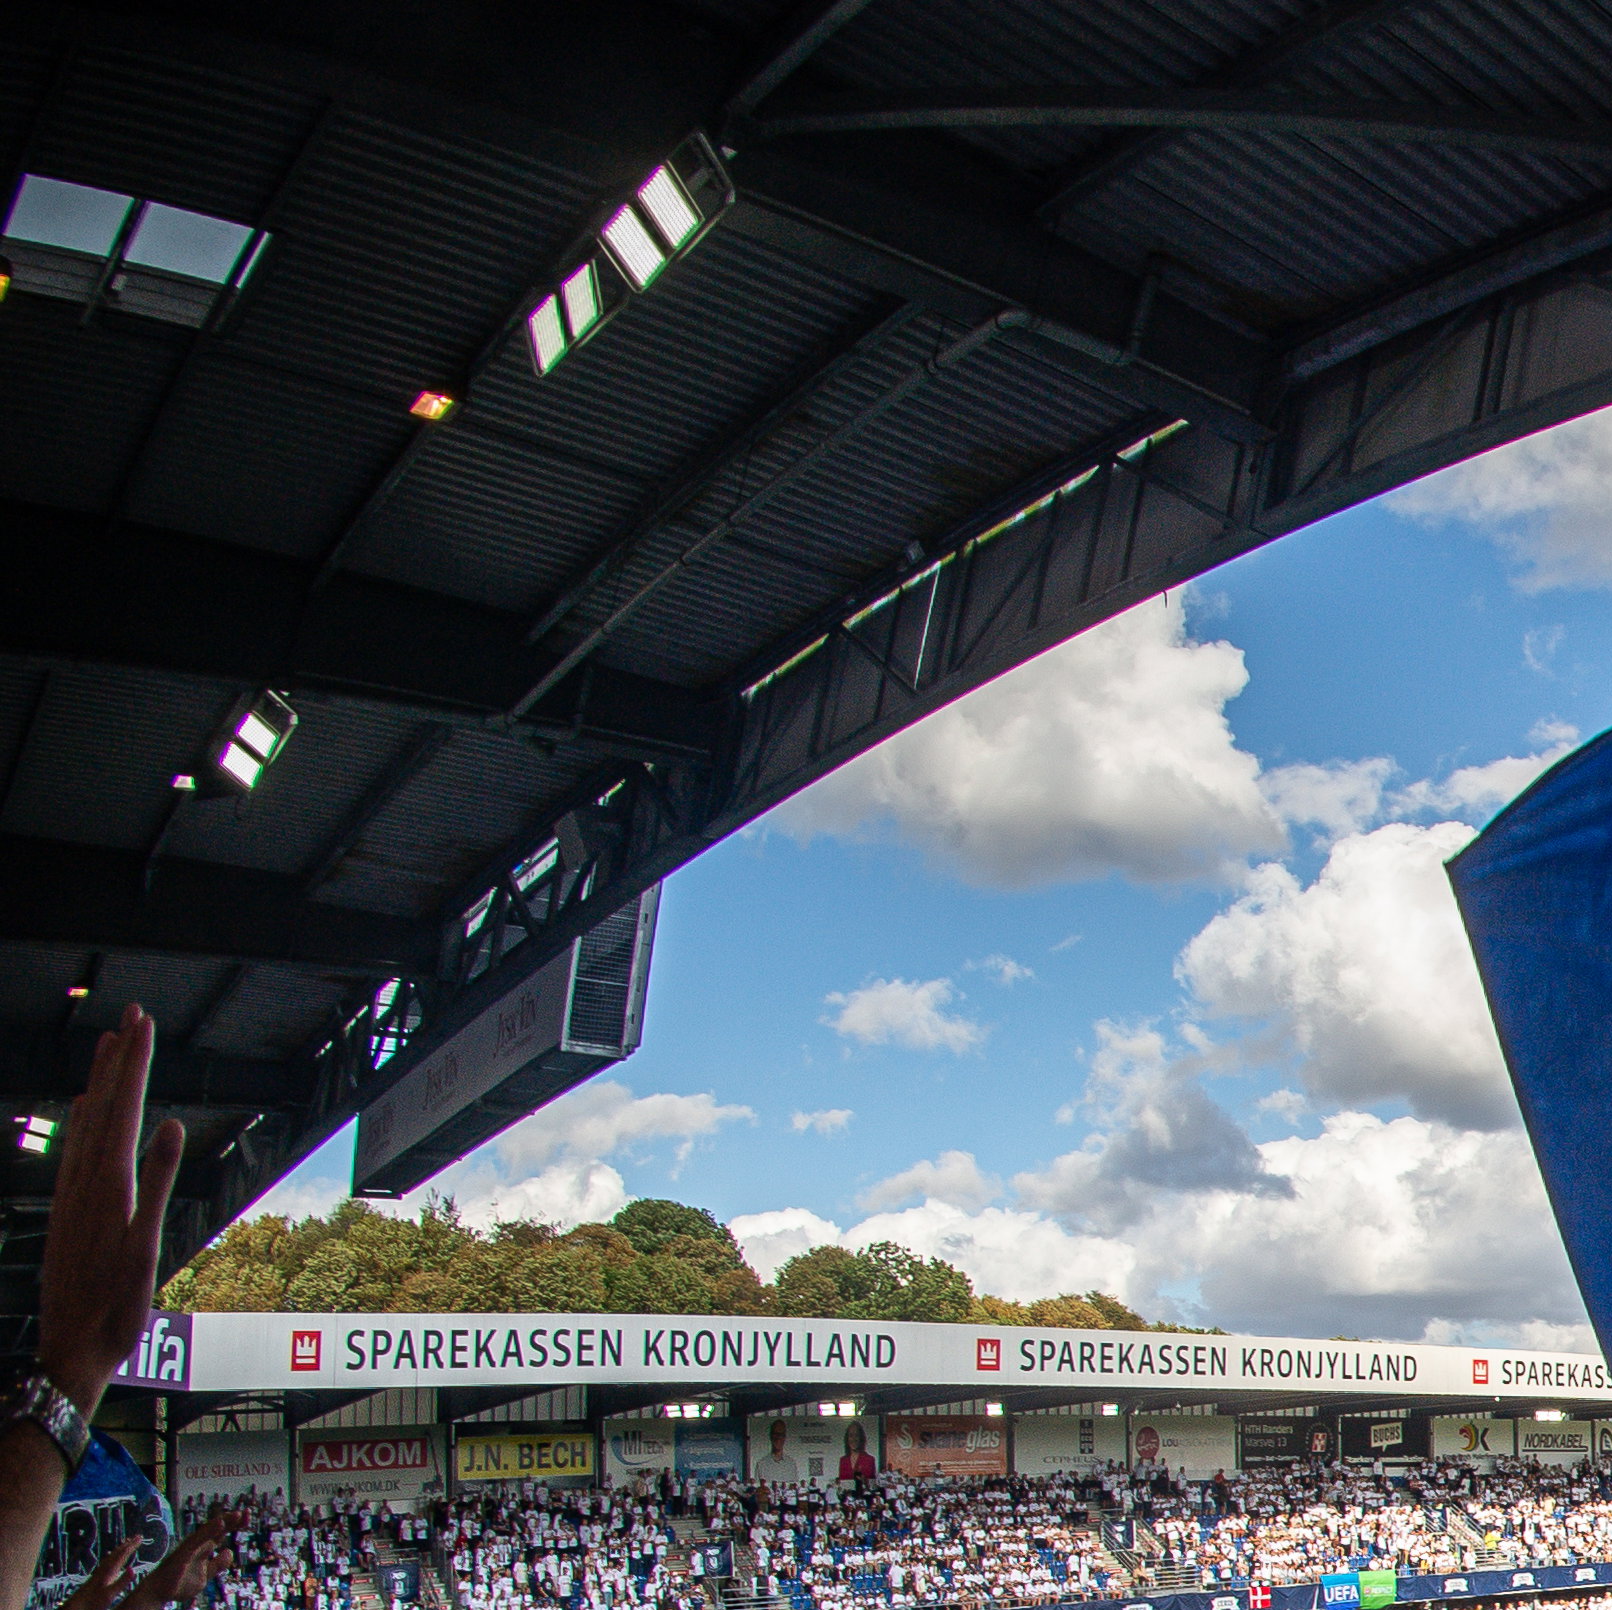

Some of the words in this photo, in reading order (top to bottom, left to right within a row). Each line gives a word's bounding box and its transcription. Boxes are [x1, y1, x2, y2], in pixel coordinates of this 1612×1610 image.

[117, 1316, 187, 1383] ifa
[345, 1328, 624, 1371] SPAREKASSEN
[643, 1328, 897, 1370] KRONJYLLAND
[1019, 1338, 1229, 1377] SPAREKASSEN
[1240, 1347, 1418, 1382] KRONJYLLAND
[309, 1440, 423, 1471] AJKOM
[463, 1446, 509, 1473] J.N.
[517, 1439, 588, 1472] BECH
[1523, 1433, 1585, 1449] NORDKABEL
[1324, 1584, 1359, 1602] UEFA
